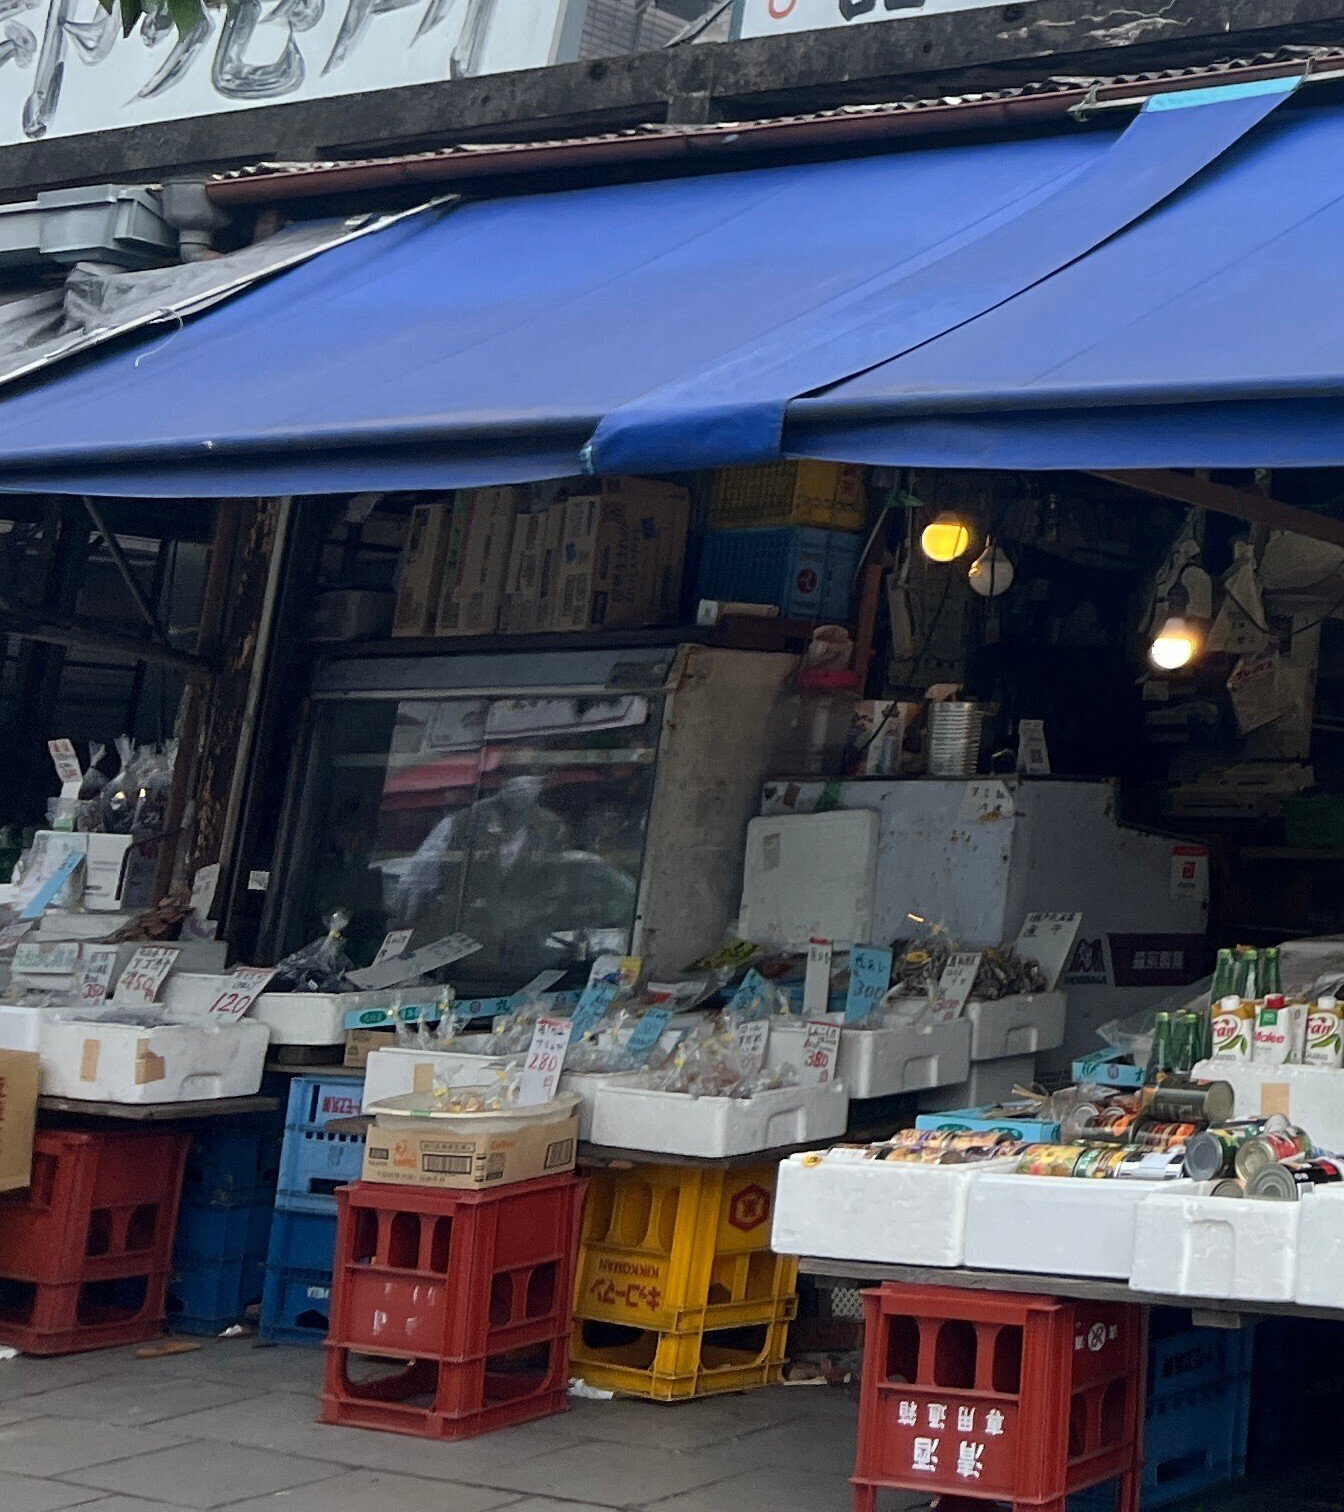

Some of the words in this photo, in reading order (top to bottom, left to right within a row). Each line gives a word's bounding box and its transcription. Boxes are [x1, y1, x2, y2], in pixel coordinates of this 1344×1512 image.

[208, 991, 252, 1014] 120
[528, 1052, 558, 1072] 280
[912, 1437, 985, 1478] 清酒
